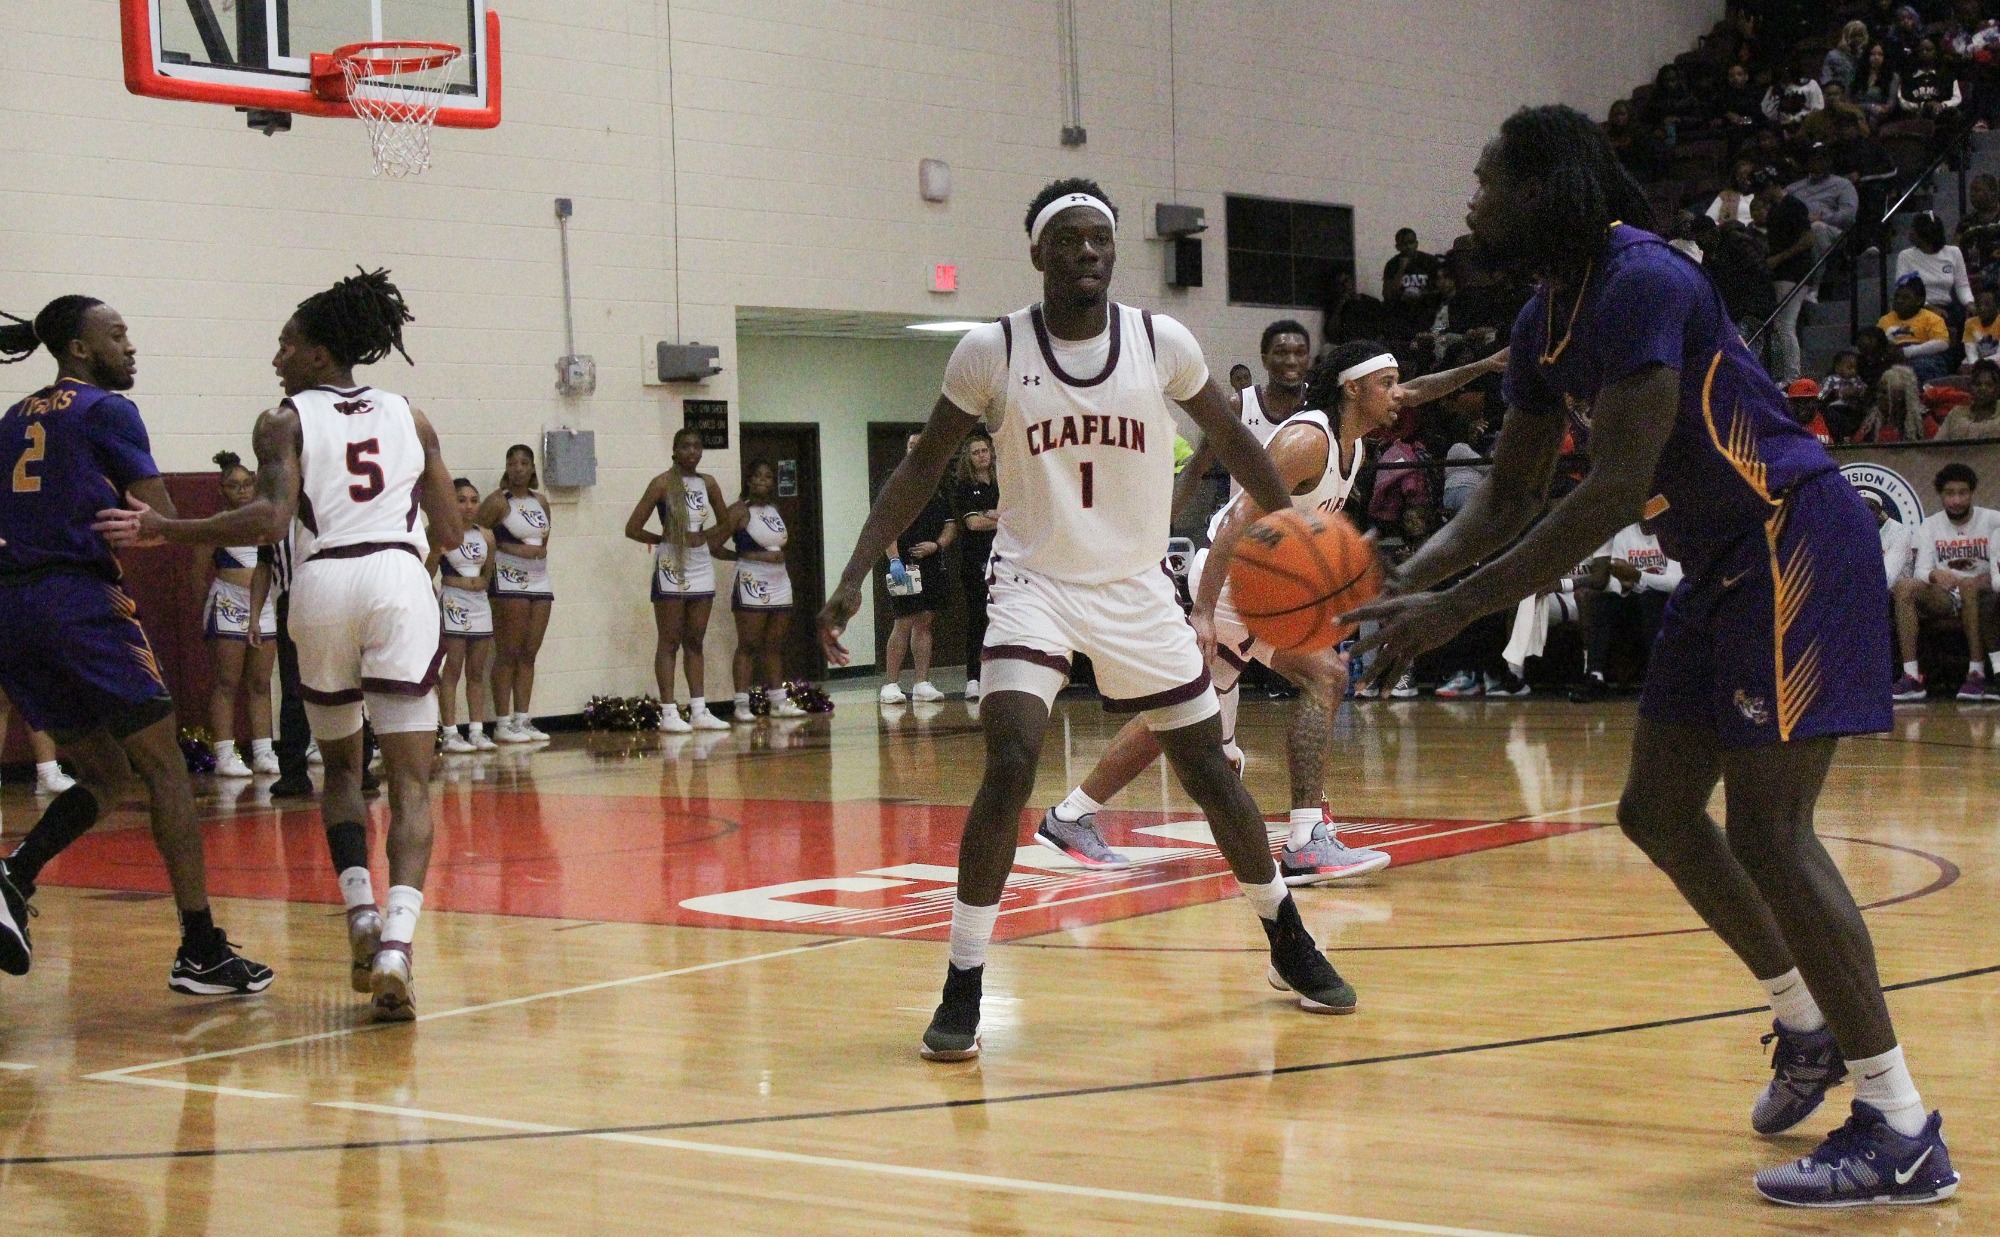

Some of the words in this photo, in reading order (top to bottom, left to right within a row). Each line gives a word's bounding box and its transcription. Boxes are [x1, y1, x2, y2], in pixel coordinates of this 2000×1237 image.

[1026, 414, 1146, 456] CLAFLIN
[12, 421, 46, 493] 2
[345, 437, 386, 504] 5
[1079, 461, 1094, 509] 1
[1847, 472, 1885, 486] ISION
[1628, 548, 1662, 557] CLAFL
[1936, 545, 1990, 562] BASKETBALL
